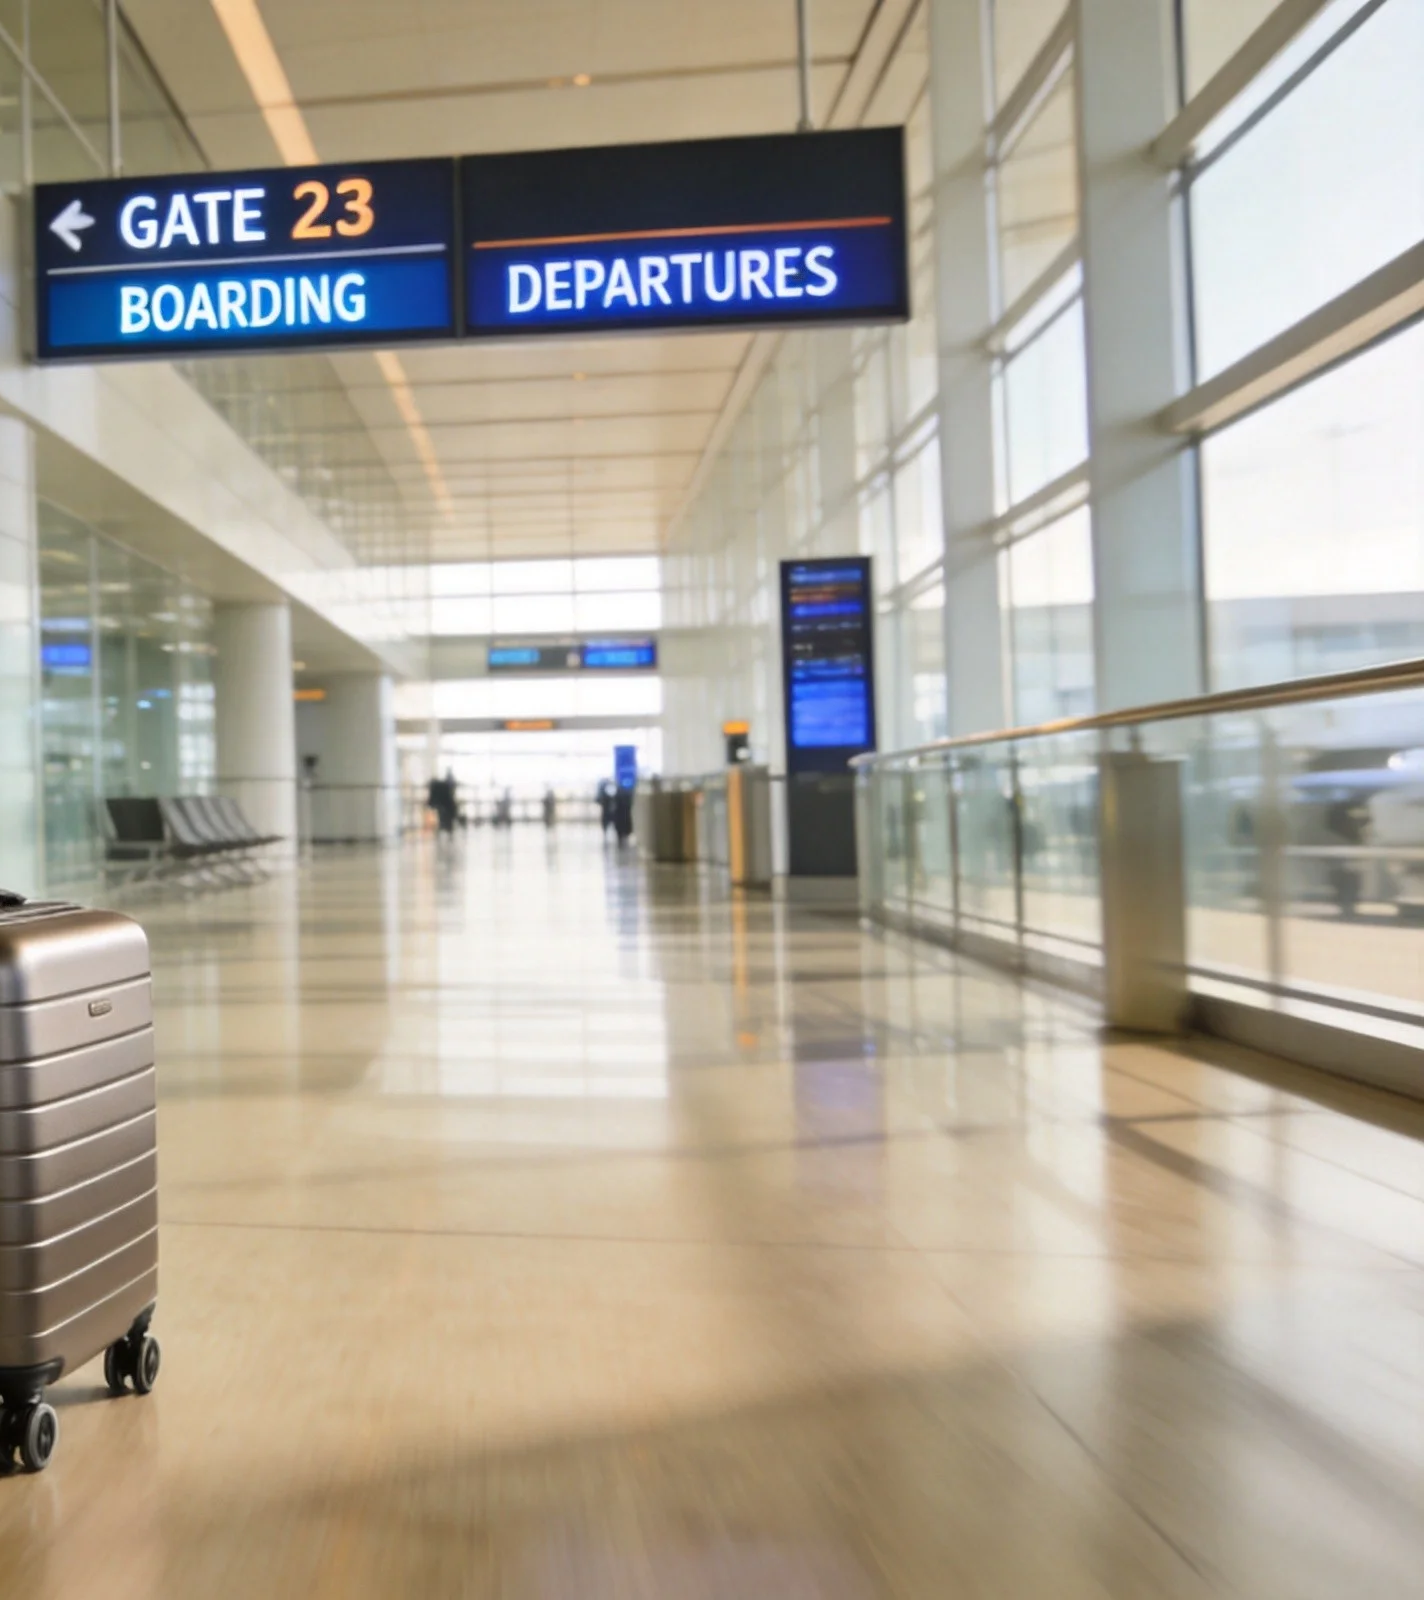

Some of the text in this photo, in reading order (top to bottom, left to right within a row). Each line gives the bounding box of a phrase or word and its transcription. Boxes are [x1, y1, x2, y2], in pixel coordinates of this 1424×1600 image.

[120, 178, 375, 249] GATE 23
[120, 273, 366, 334] BOARDING
[508, 246, 838, 313] DEPARTURES
